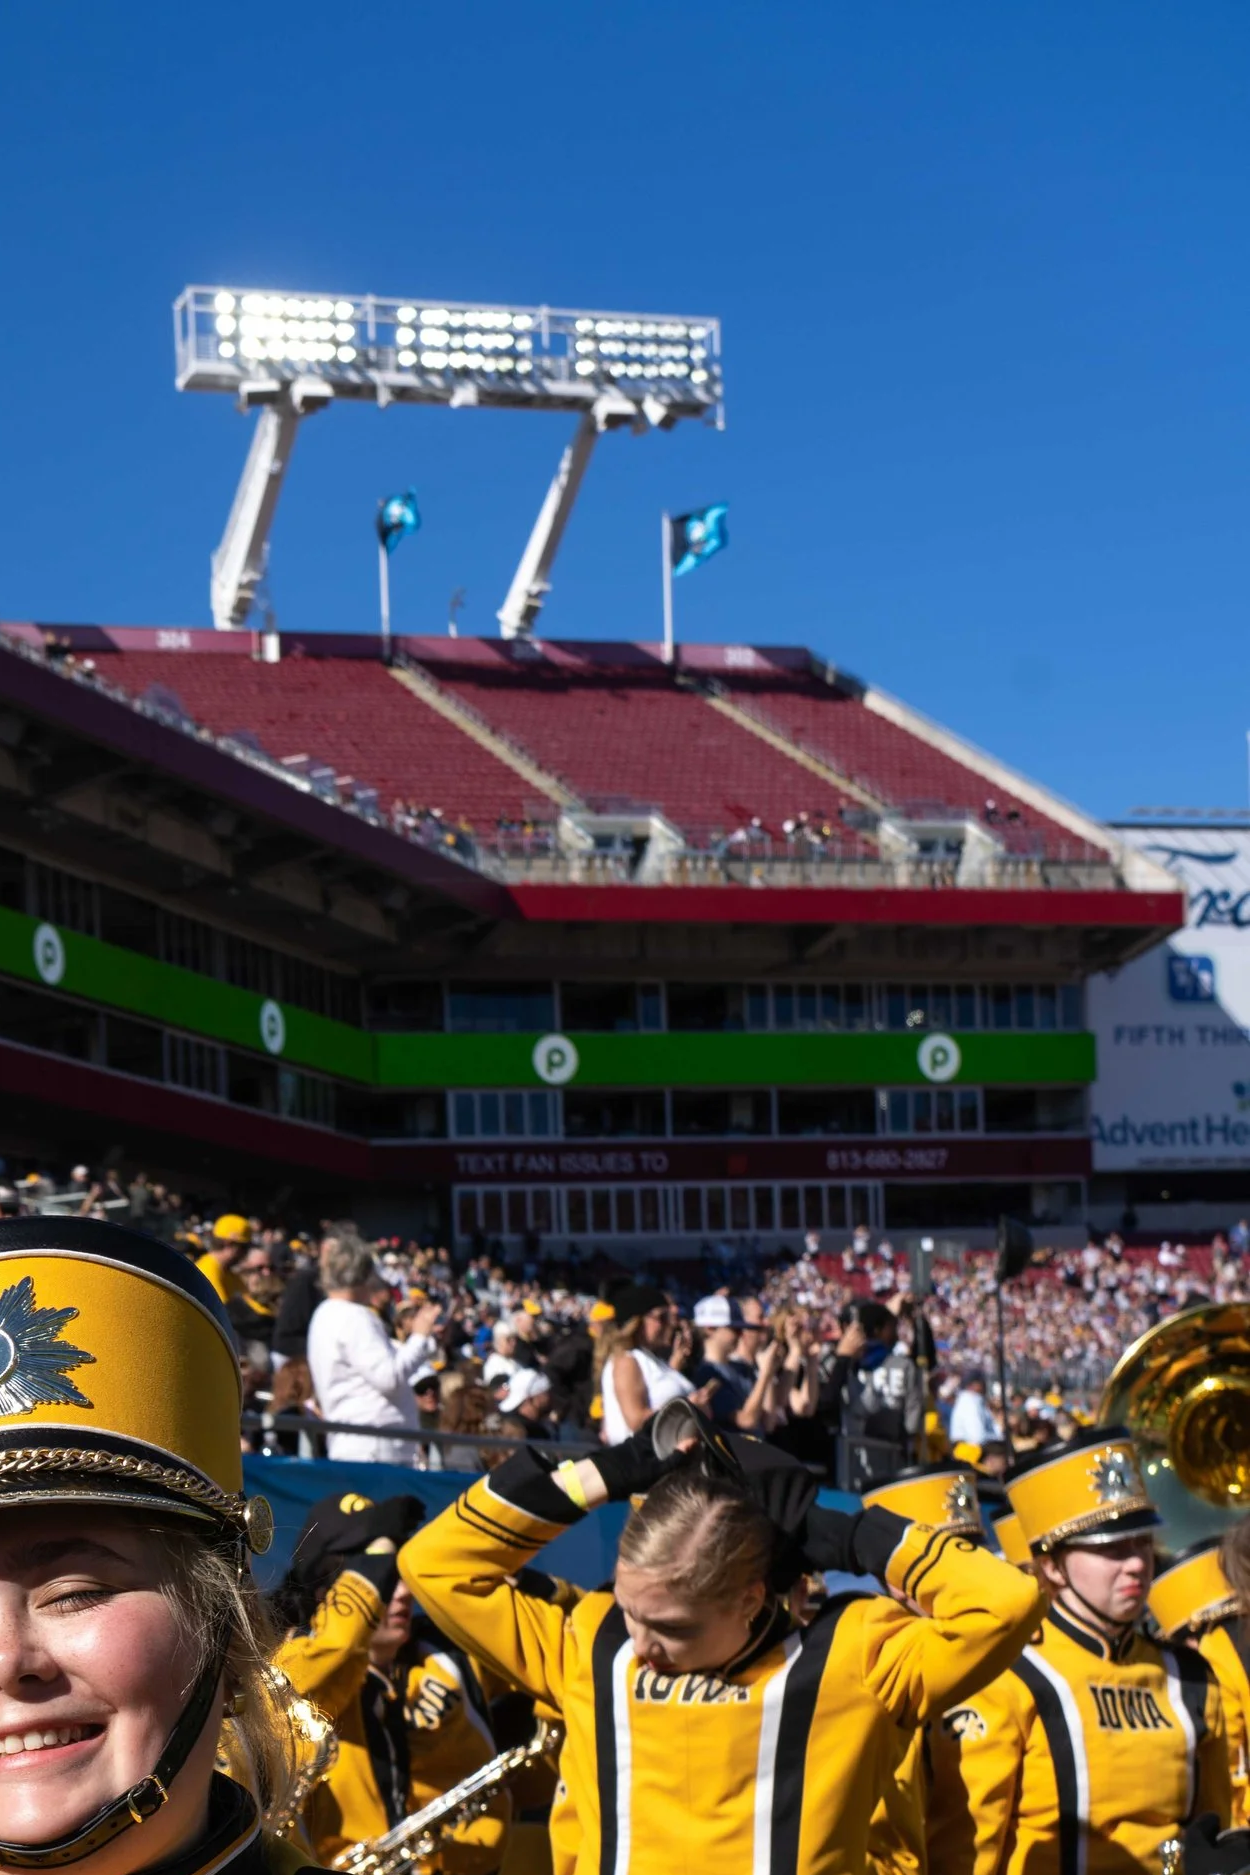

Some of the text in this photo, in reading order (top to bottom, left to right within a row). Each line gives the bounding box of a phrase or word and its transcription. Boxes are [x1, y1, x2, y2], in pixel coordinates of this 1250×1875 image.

[1114, 1024, 1185, 1046] FIFTH
[457, 1152, 669, 1174] TEXT FAN ISSUES TO
[1089, 1684, 1174, 1731] IOWA
